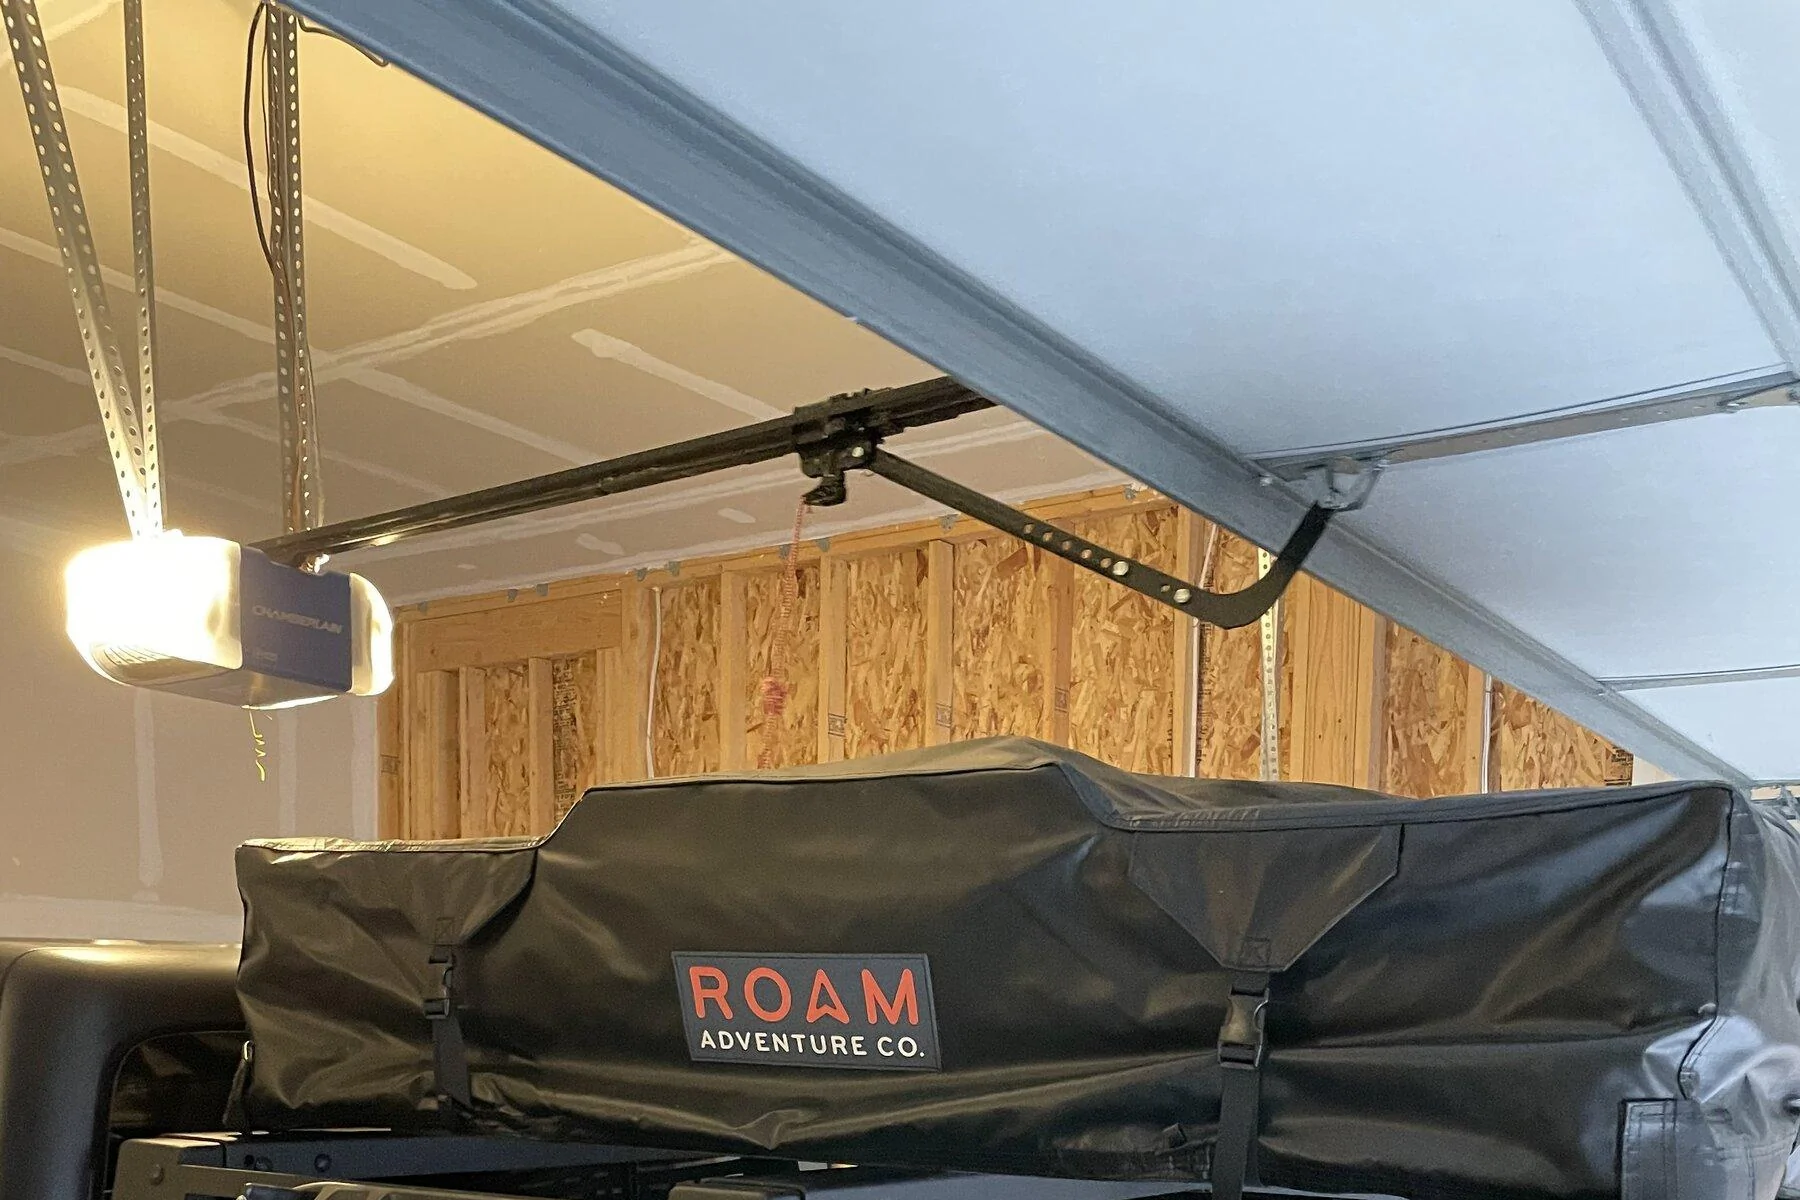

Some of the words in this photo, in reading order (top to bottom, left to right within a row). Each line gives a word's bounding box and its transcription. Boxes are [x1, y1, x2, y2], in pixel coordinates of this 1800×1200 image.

[689, 966, 919, 1025] ROAM
[700, 1029, 867, 1056] ADVENTURE
[877, 1036, 925, 1057] CO.
